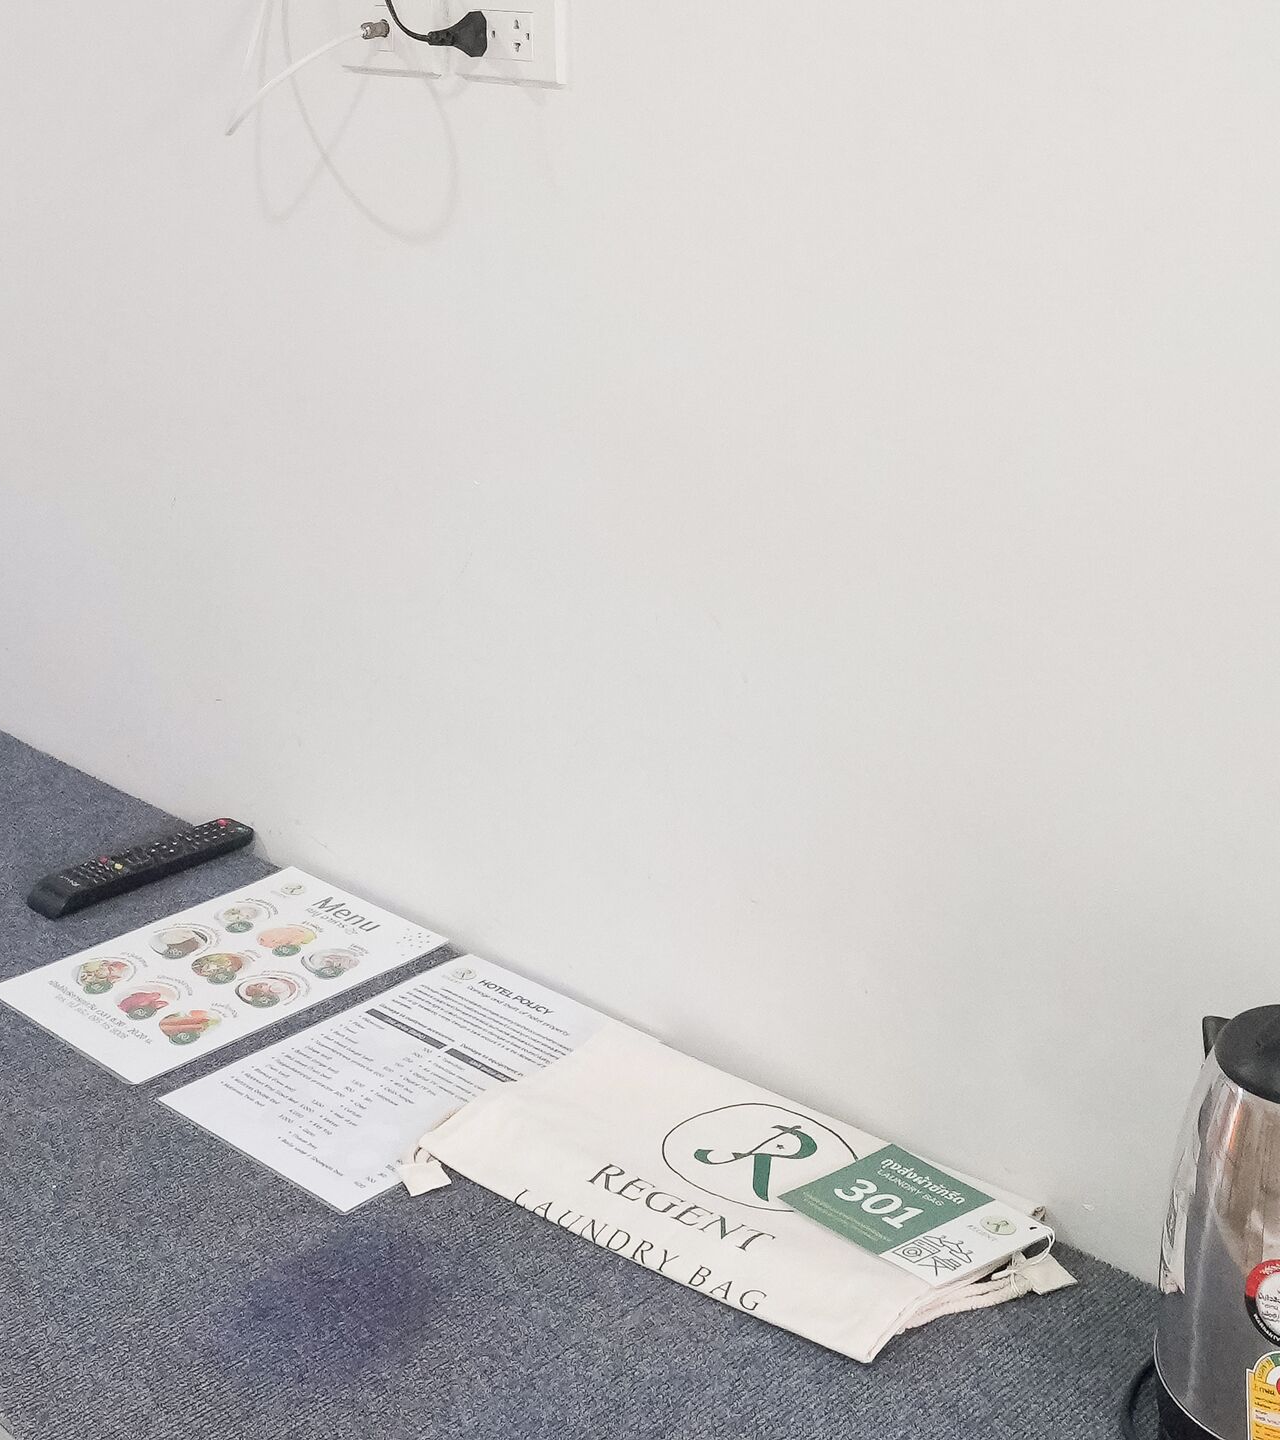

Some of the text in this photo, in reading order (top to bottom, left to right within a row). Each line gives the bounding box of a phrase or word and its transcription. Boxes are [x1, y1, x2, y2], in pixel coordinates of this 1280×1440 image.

[312, 896, 381, 932] Menu
[477, 979, 514, 999] HOTEL
[512, 995, 554, 1015] POLICY
[586, 1163, 776, 1252] REGENT
[833, 1178, 924, 1230] 301
[876, 1170, 946, 1207] LAUNDRY BAG
[514, 1188, 768, 1311] LAUNDRY BAG
